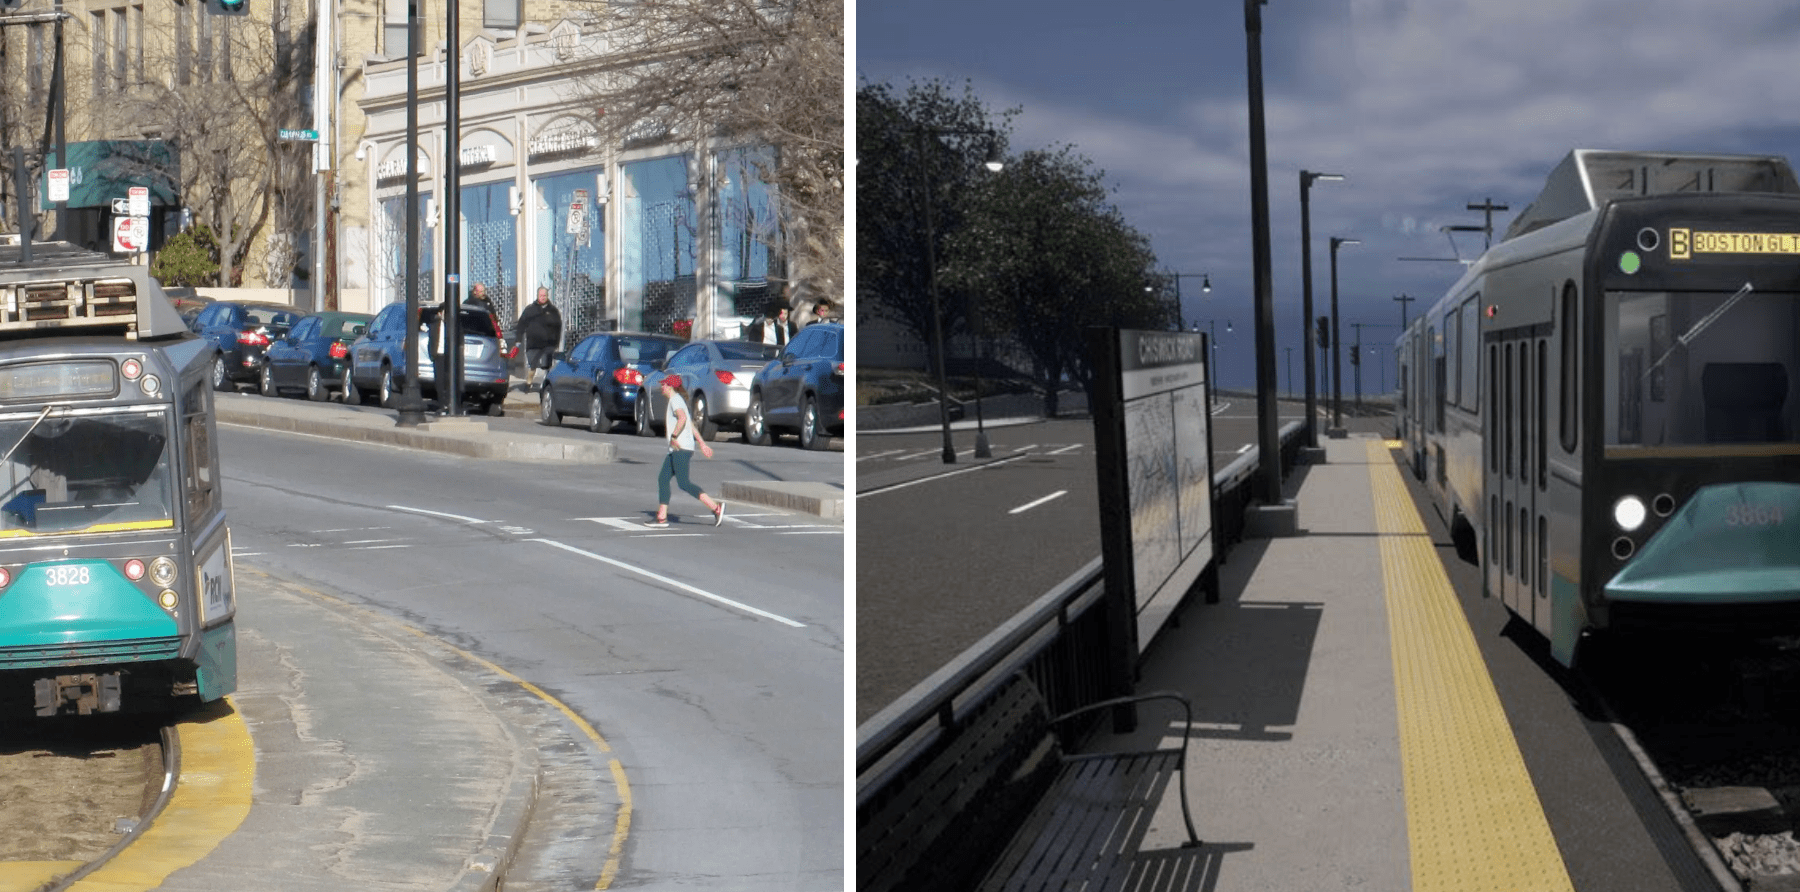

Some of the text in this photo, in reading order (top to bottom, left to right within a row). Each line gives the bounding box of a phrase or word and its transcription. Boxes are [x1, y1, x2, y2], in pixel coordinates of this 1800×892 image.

[1672, 230, 1688, 255] B
[1693, 234, 1763, 252] BOSTON
[46, 566, 90, 586] 3828
